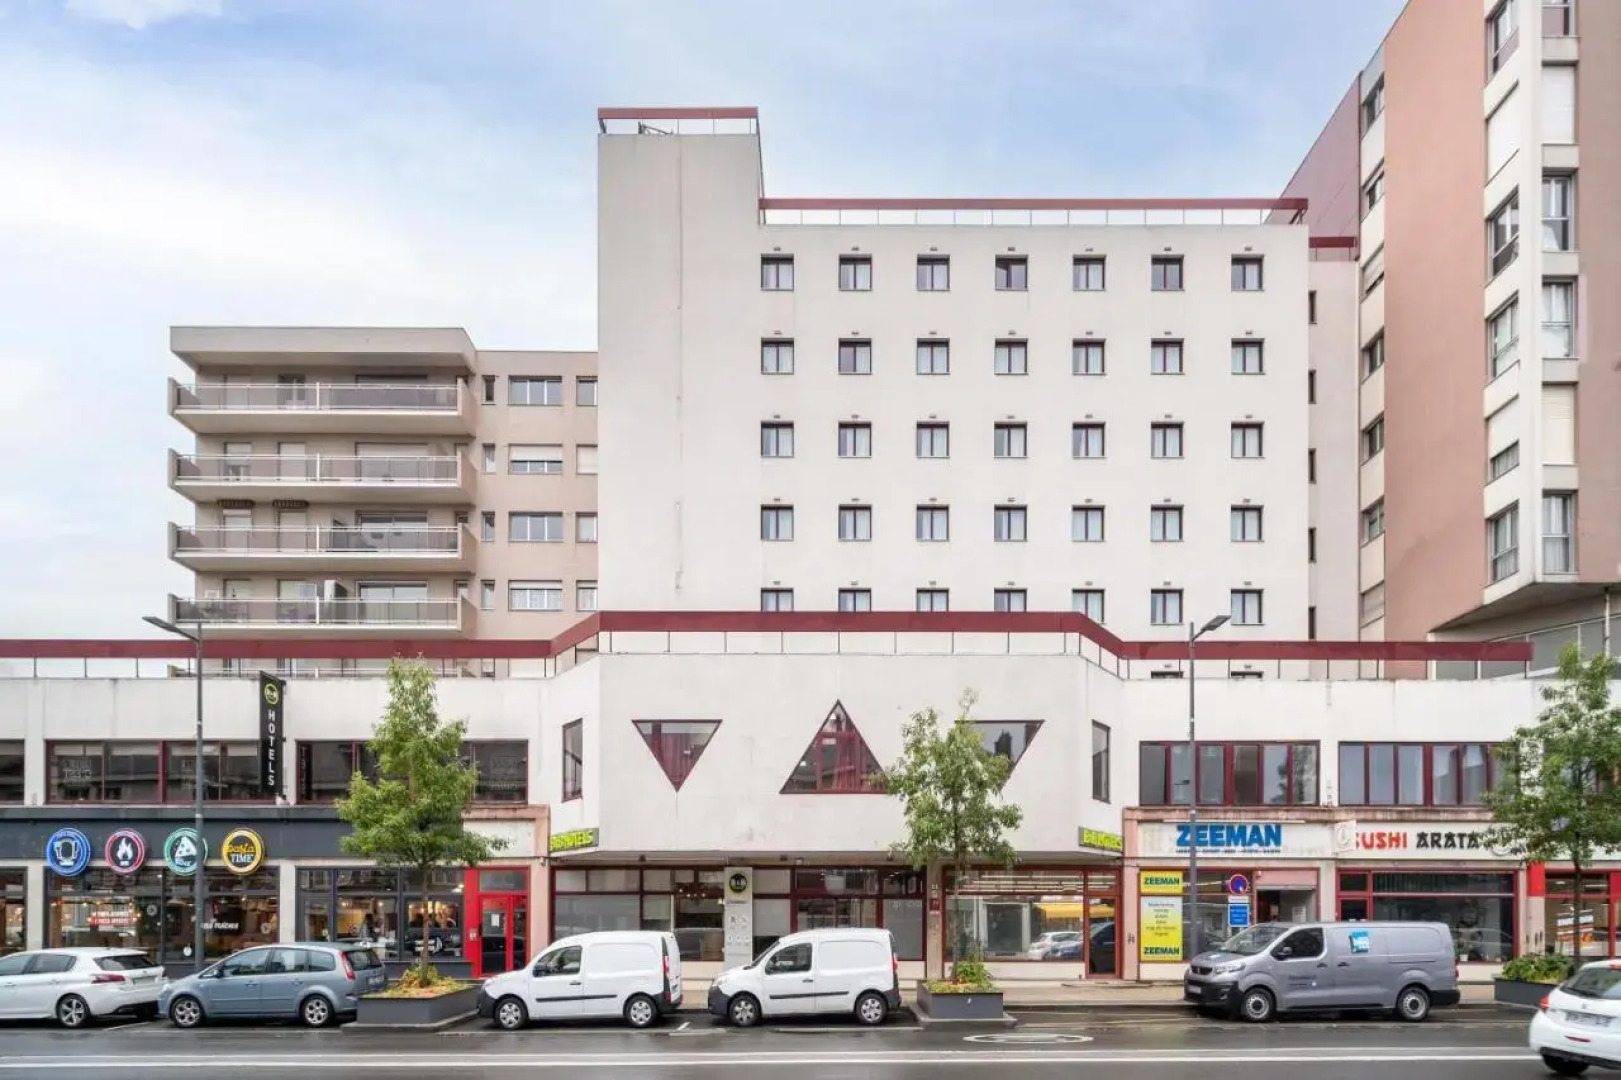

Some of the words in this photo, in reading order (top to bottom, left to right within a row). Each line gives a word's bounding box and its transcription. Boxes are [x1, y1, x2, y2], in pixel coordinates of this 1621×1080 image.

[1176, 825, 1282, 847] ZEEMAN
[1356, 832, 1408, 849] USHI
[1416, 831, 1480, 849] ARATA
[231, 853, 255, 863] TIME
[1144, 877, 1180, 885] ZEEMAN
[1144, 947, 1180, 955] ZEEMAN
